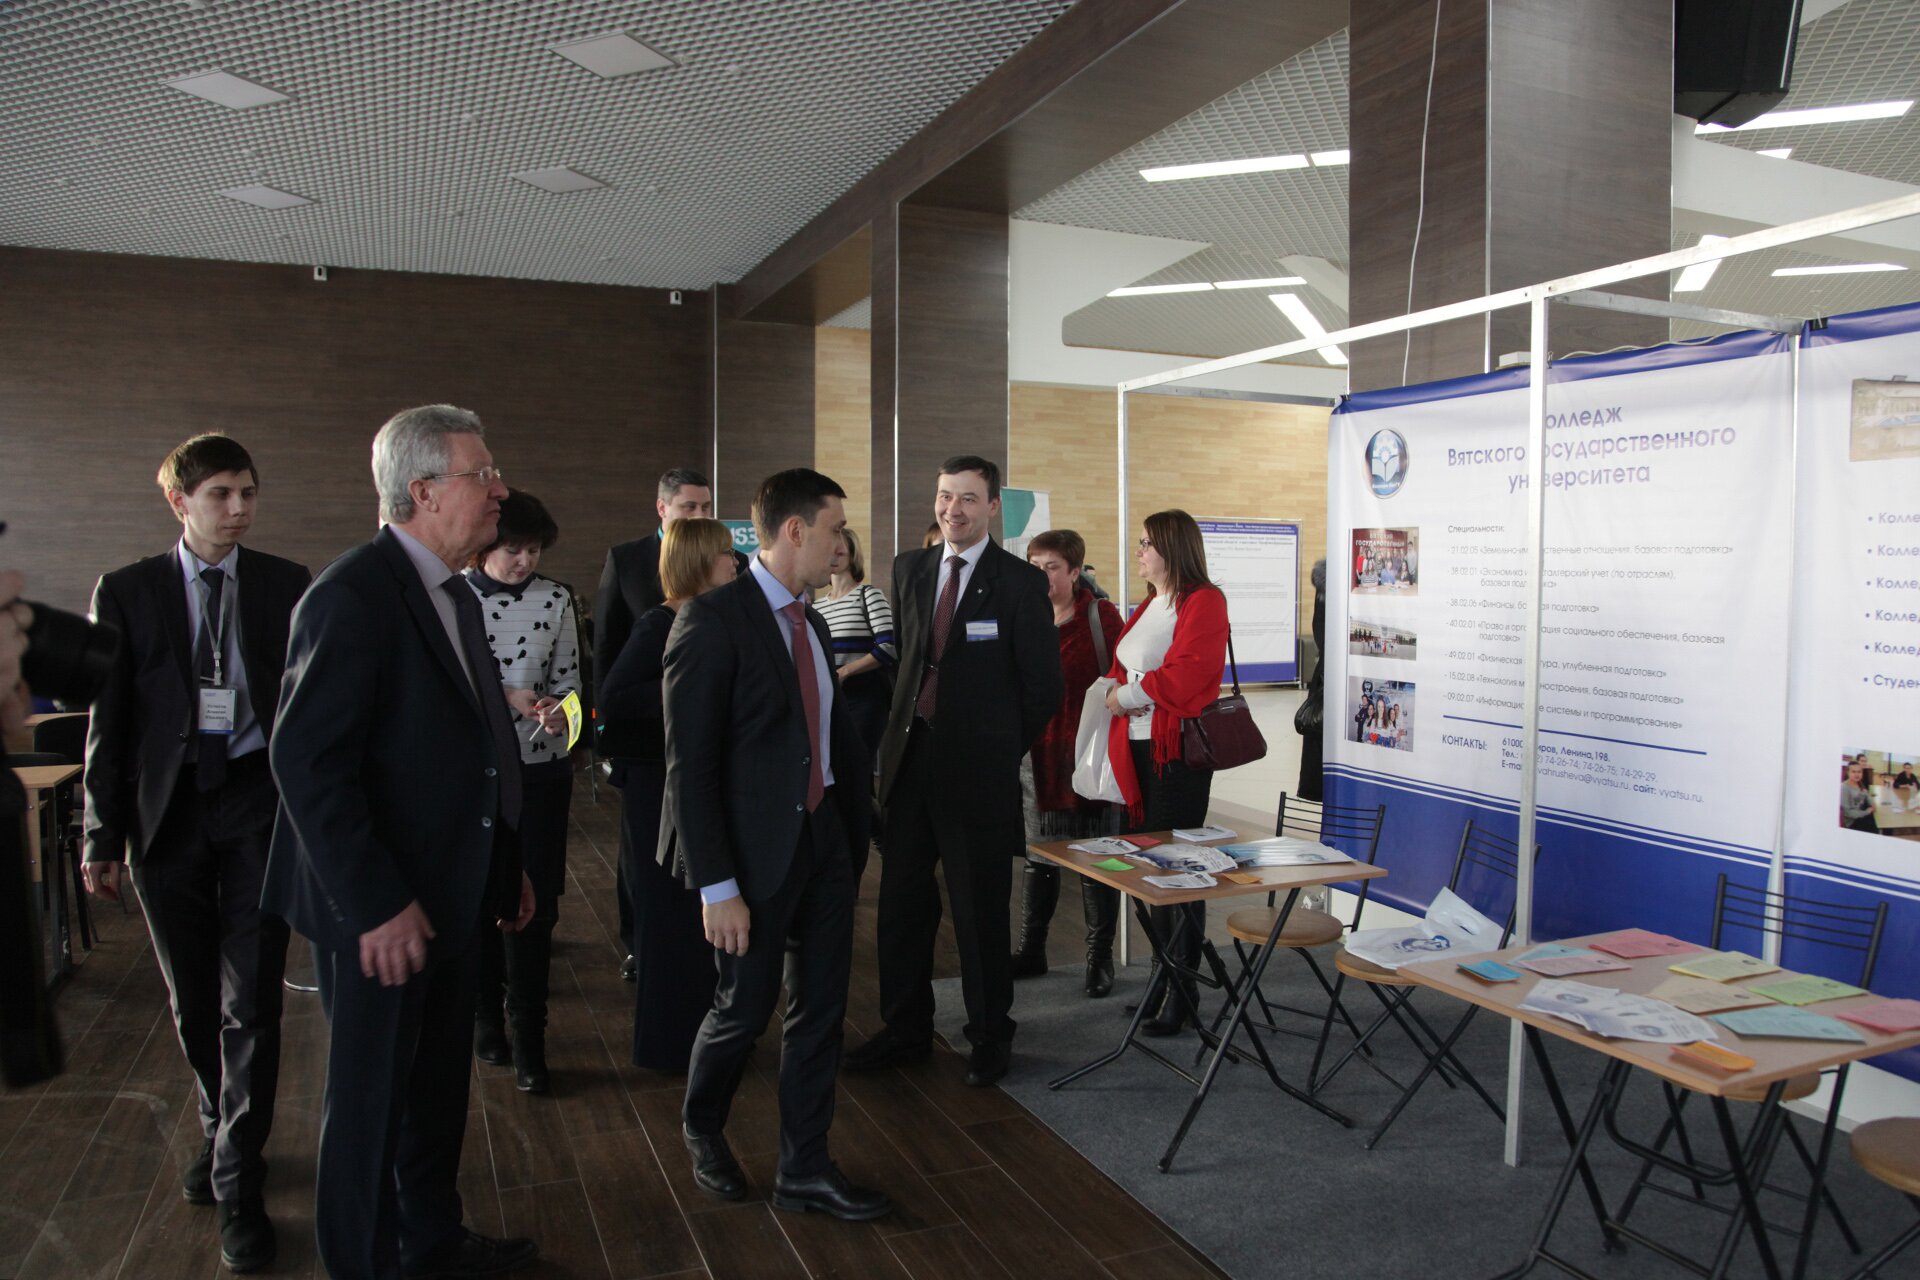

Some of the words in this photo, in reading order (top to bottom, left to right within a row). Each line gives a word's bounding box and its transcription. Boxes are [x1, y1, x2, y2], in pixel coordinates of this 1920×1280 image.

[1545, 407, 1622, 429] олледж
[1448, 446, 1526, 466] Вятского
[1544, 427, 1736, 461] осударственного
[1508, 466, 1650, 494] унверситета
[1447, 524, 1505, 534] Специальности:
[1634, 544, 1673, 554] базовая
[1591, 570, 1609, 579] учет
[1876, 577, 1920, 589] Колле
[1875, 610, 1920, 622] Колле
[1562, 627, 1615, 638] социального
[1682, 633, 1725, 645] базовая
[1448, 651, 1475, 660] 49.02.01
[1562, 661, 1612, 674] углубленная
[1614, 667, 1667, 679] подготовка»
[1449, 672, 1475, 682] 15.02.08
[1592, 686, 1628, 699] базовая
[1629, 691, 1685, 705] подготовка»
[1447, 692, 1474, 702] 09.02.07
[1546, 705, 1581, 717] системы
[1590, 711, 1683, 730] программирование»
[1442, 734, 1488, 750] КОНТАКТЫ:
[1502, 748, 1519, 759] Тел.:
[1633, 783, 1657, 795] сайт:
